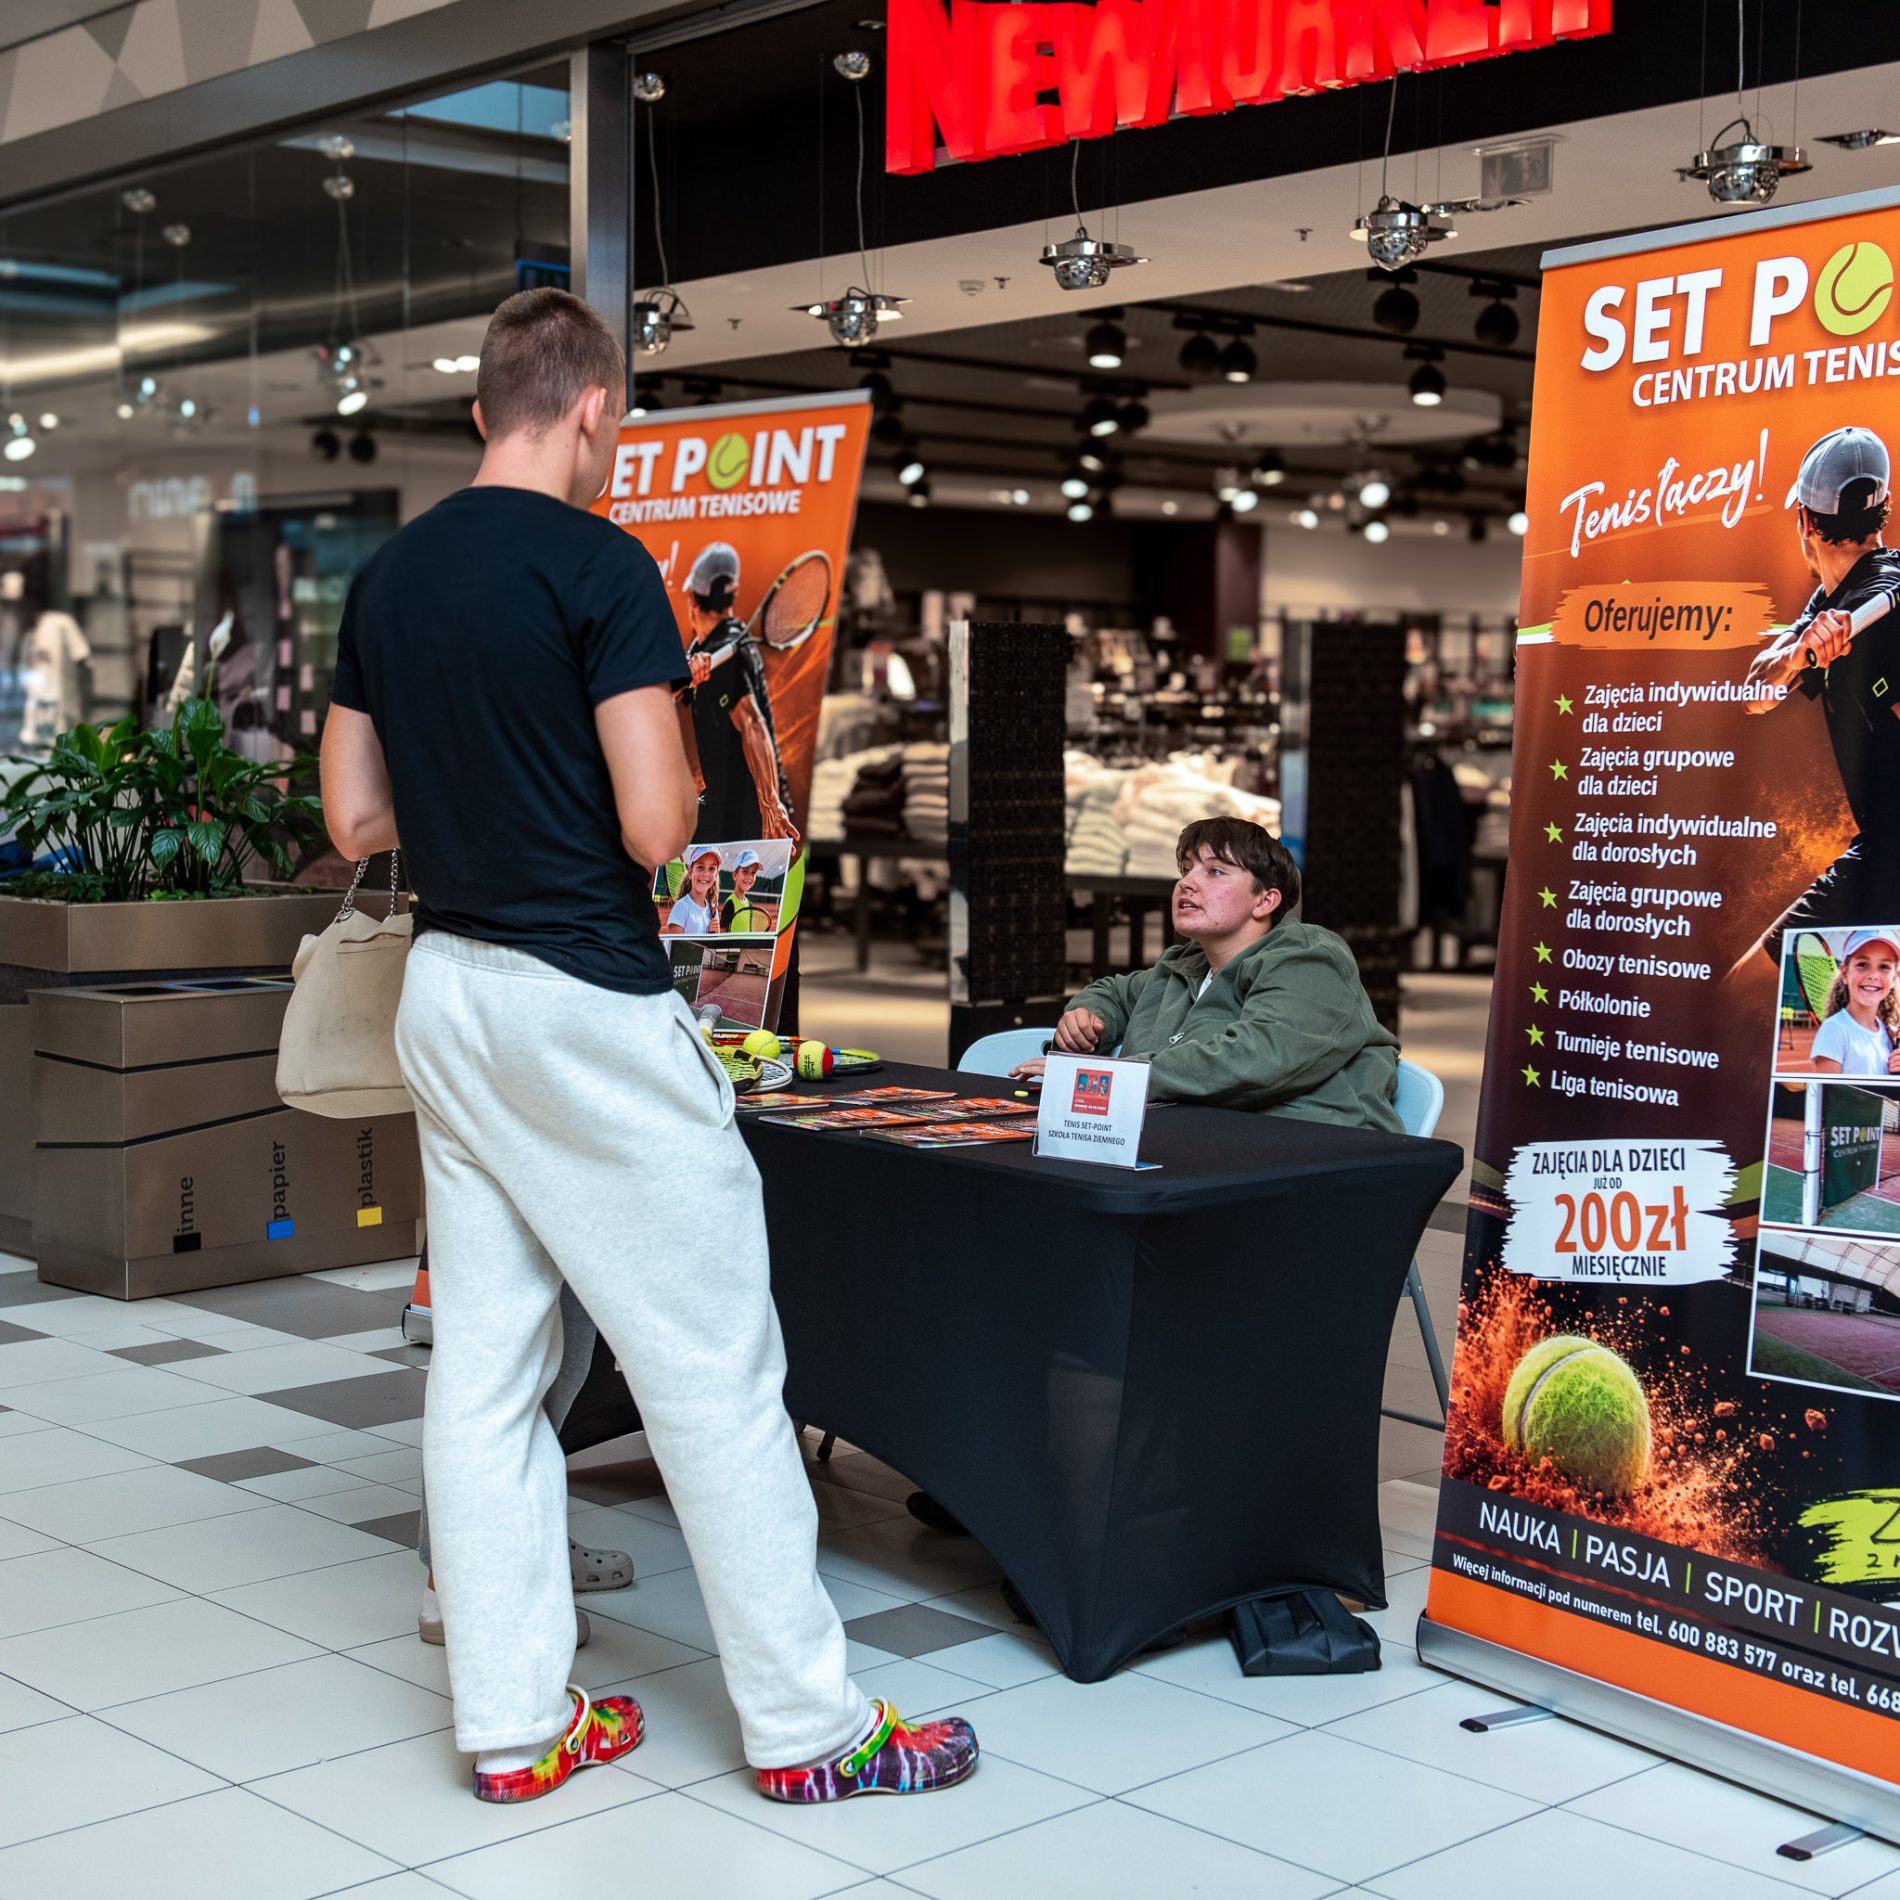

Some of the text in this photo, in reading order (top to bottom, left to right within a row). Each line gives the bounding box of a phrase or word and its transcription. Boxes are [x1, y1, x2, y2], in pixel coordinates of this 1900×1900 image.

[1580, 267, 1723, 372] SET
[1632, 353, 1796, 408] CENTRUM
[598, 424, 846, 498] ET POINT
[609, 489, 801, 526] CENTRUM TENISOWE
[1559, 427, 1769, 558] Tenis łączy!
[1584, 597, 1733, 641] Oferujemy:
[1584, 678, 1788, 708] Zajęcia indywidualne
[1582, 711, 1662, 734] dla dzieci
[1580, 746, 1735, 774] Zajęcia grupowe
[1578, 774, 1658, 797] dla dzieci
[1574, 812, 1777, 841] Zajęcia indywidualne
[1572, 841, 1697, 870] dla dorosłych
[1568, 879, 1722, 913] Zajęcia grupowe
[1566, 908, 1691, 939] dla dorosłych
[1562, 947, 1712, 981] Obozy tenisowe
[1558, 988, 1651, 1019] Półkolonie
[1555, 1030, 1720, 1070] Turnieje tenisowe
[1550, 1070, 1679, 1107] Liga tenisowa
[1048, 1130, 1125, 1145] SZKOŁA TENISA ZIEMNEGO
[1064, 1120, 1112, 1132] TENIS SET-POINT
[1830, 1126, 1880, 1146] SET POINT
[269, 1141, 290, 1220] papier
[357, 1127, 377, 1208] plastik
[1532, 1147, 1686, 1180] ZAJĘCIA DLA DZIECI
[1593, 1174, 1622, 1190] JUŻ OD
[177, 1176, 194, 1233] inne
[1554, 1185, 1689, 1254] 200zł
[1572, 1255, 1667, 1281] MIESIĘCZNIE
[1479, 1501, 1561, 1555] NAUKA
[1585, 1534, 1671, 1589] PASJA
[1704, 1571, 1804, 1627] SPORT
[1453, 1552, 1489, 1581] Więcej
[1491, 1566, 1546, 1600] informacji
[1548, 1588, 1571, 1606] pod
[1573, 1597, 1632, 1626] numerem
[1636, 1610, 1663, 1636] tel.
[1668, 1619, 1700, 1647] 600
[1705, 1631, 1739, 1660] 883
[1744, 1643, 1777, 1672] 577
[1782, 1661, 1825, 1689] oraz
[1830, 1673, 1860, 1700] tel.
